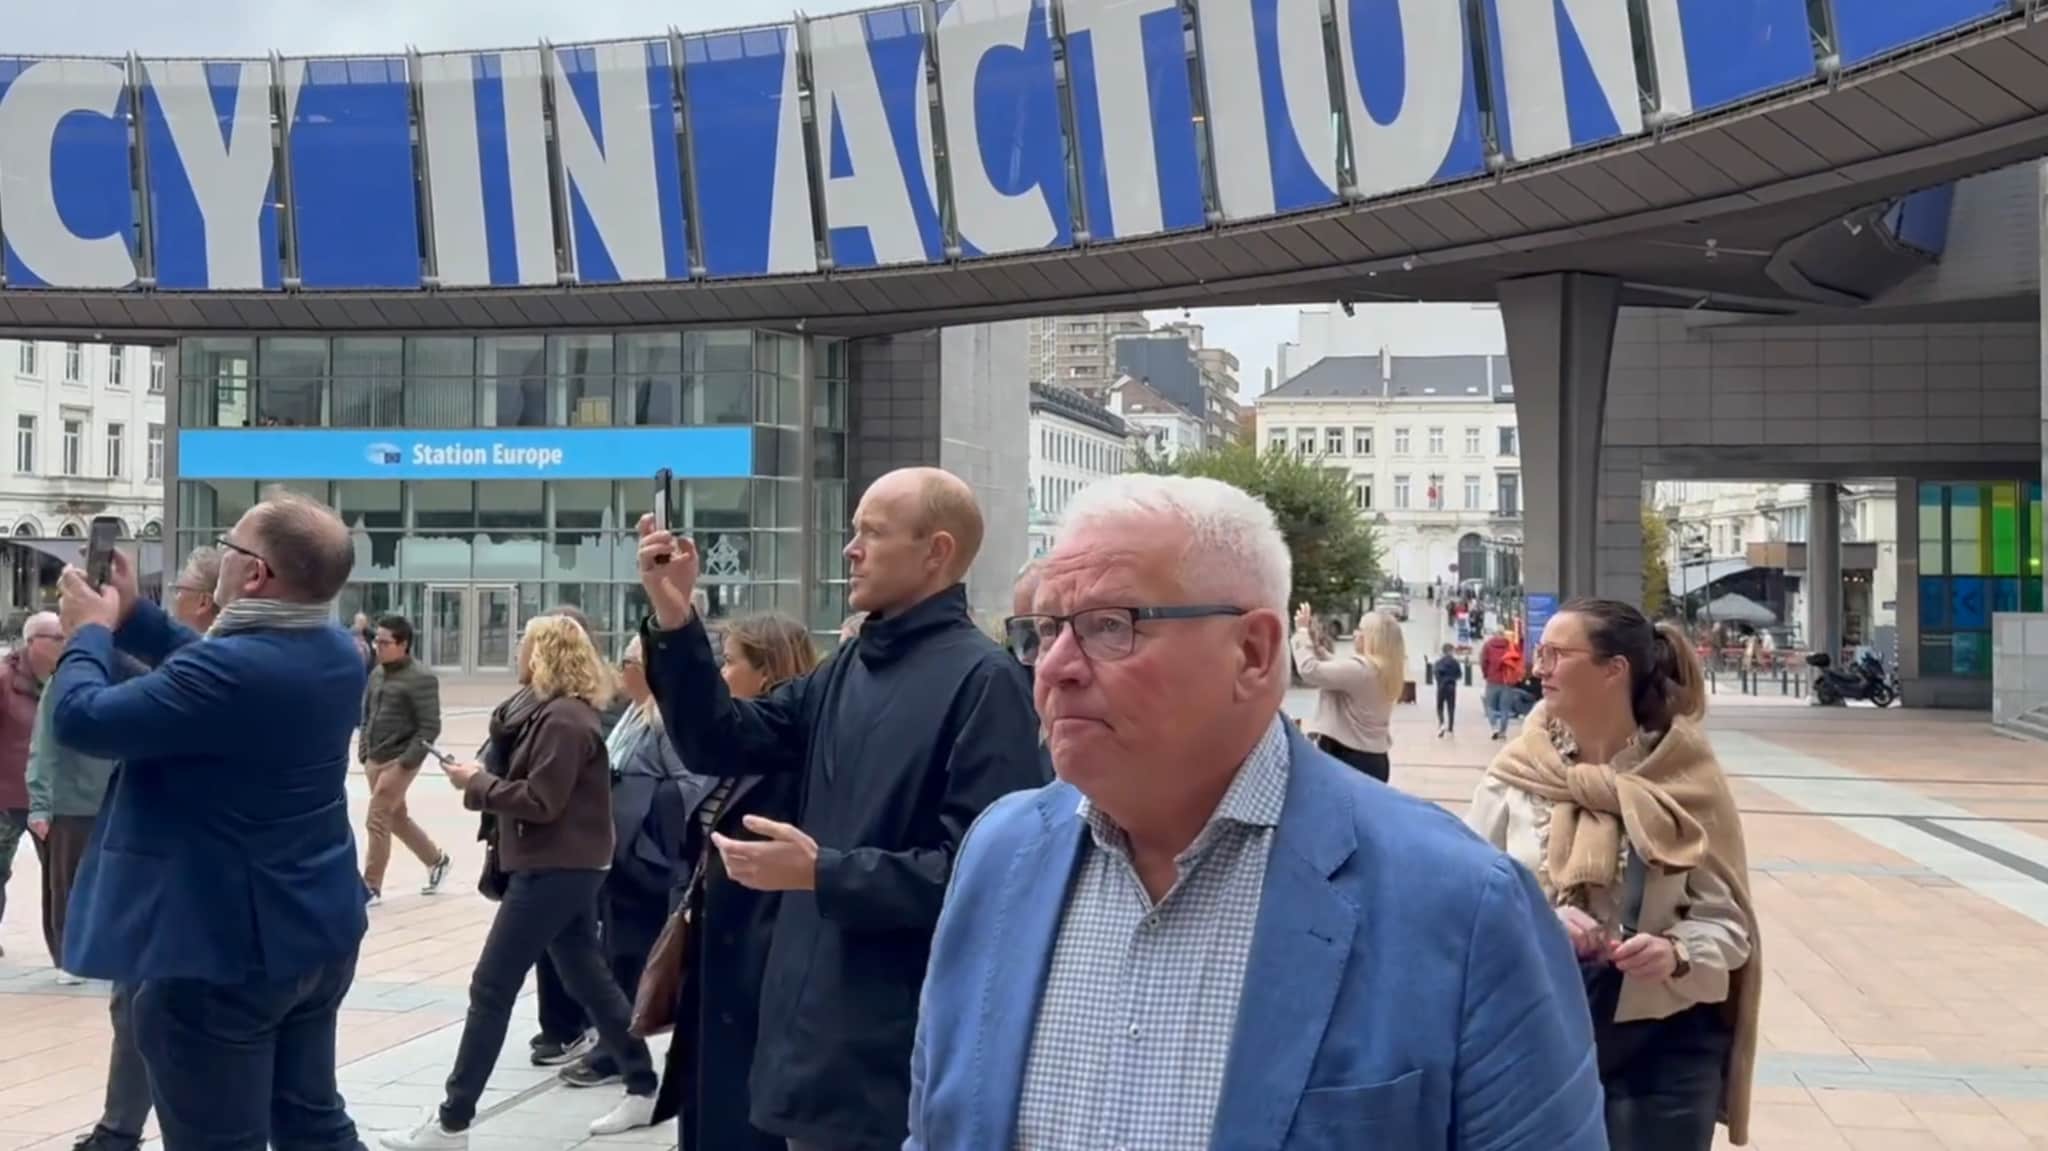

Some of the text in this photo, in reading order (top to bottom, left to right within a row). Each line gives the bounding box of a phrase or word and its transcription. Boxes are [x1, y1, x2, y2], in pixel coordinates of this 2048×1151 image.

[420, 42, 667, 287] IN
[766, 0, 1692, 274] ACTION
[412, 443, 563, 470] Station Europe
